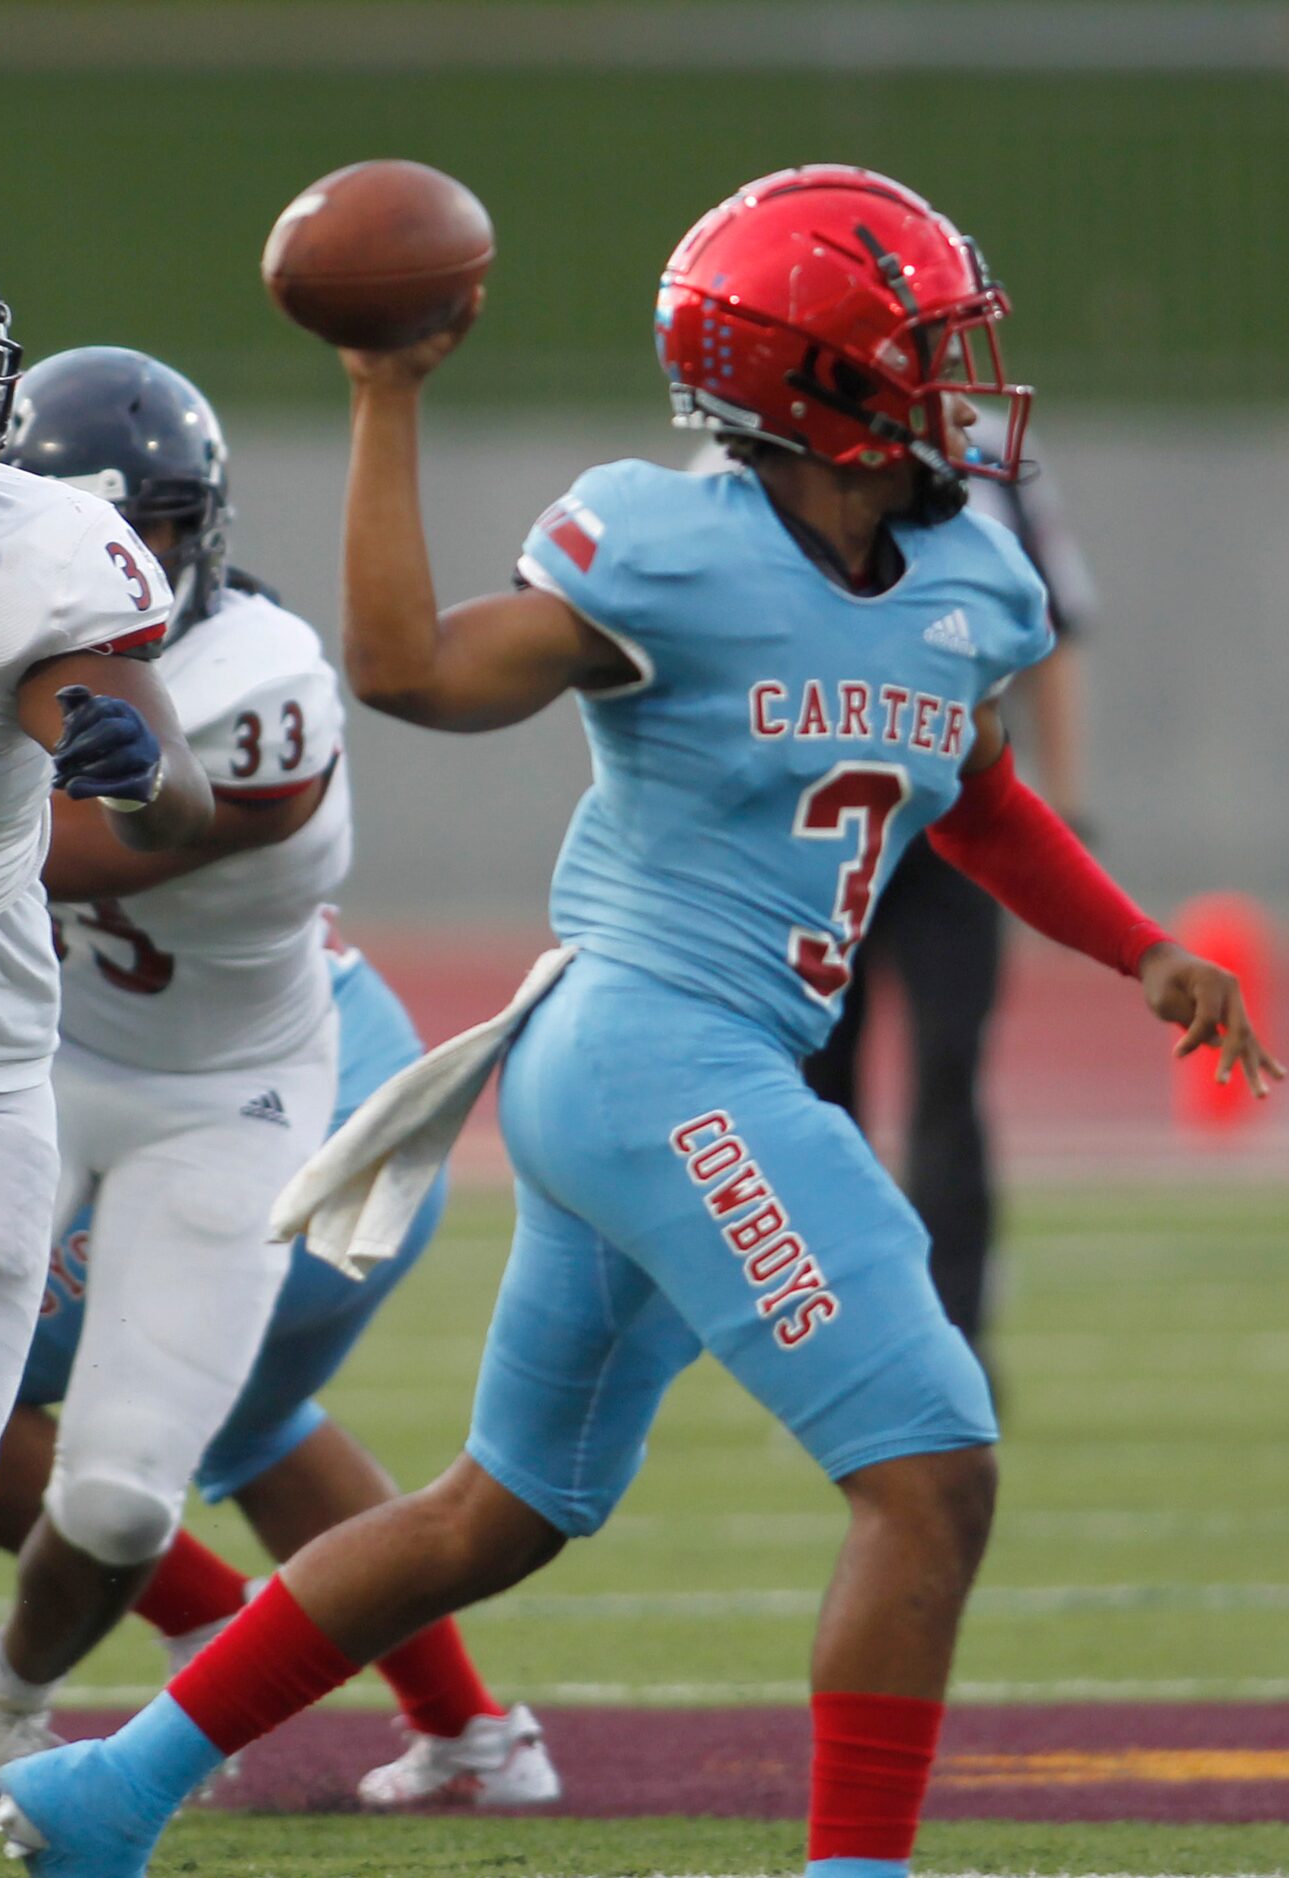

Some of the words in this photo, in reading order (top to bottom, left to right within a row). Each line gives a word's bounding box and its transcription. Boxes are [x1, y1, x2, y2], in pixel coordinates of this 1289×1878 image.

[106, 530, 162, 611] 3
[229, 698, 305, 778] 33
[748, 679, 969, 760] CARTER
[786, 760, 910, 1011] 3
[668, 1108, 841, 1352] COWBOYS
